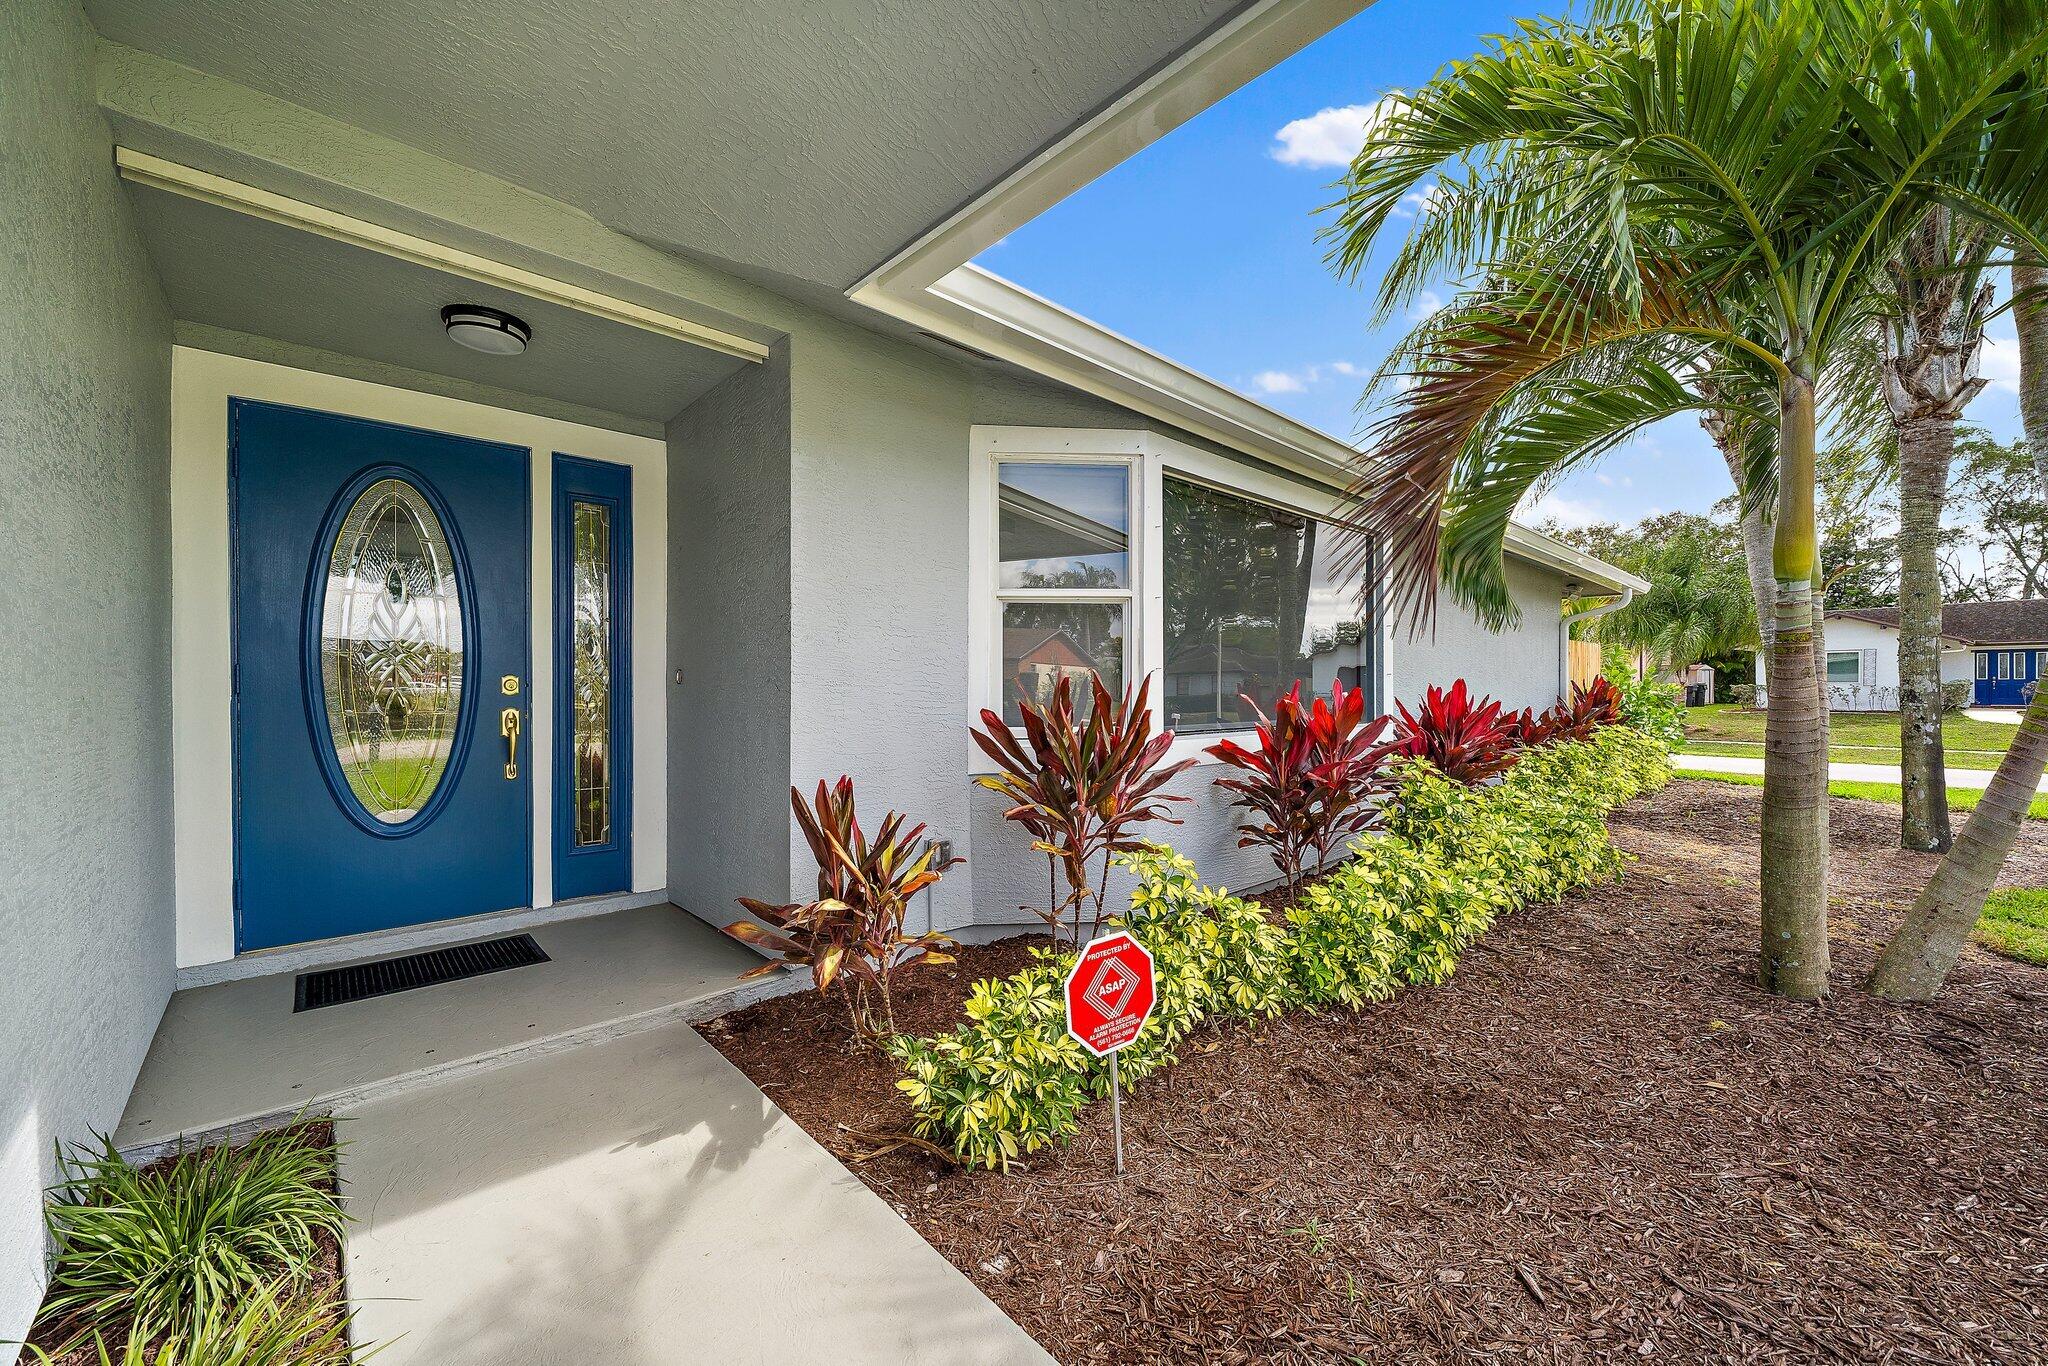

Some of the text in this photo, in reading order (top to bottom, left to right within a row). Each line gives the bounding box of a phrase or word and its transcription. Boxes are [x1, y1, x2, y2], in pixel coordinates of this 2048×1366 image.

[1087, 942, 1131, 961] PROTECTED BY
[1099, 979, 1126, 996] ASAP
[1089, 1017, 1141, 1042] ALARM PROTECTION
[1093, 1013, 1136, 1034] ALWAYS SECURE
